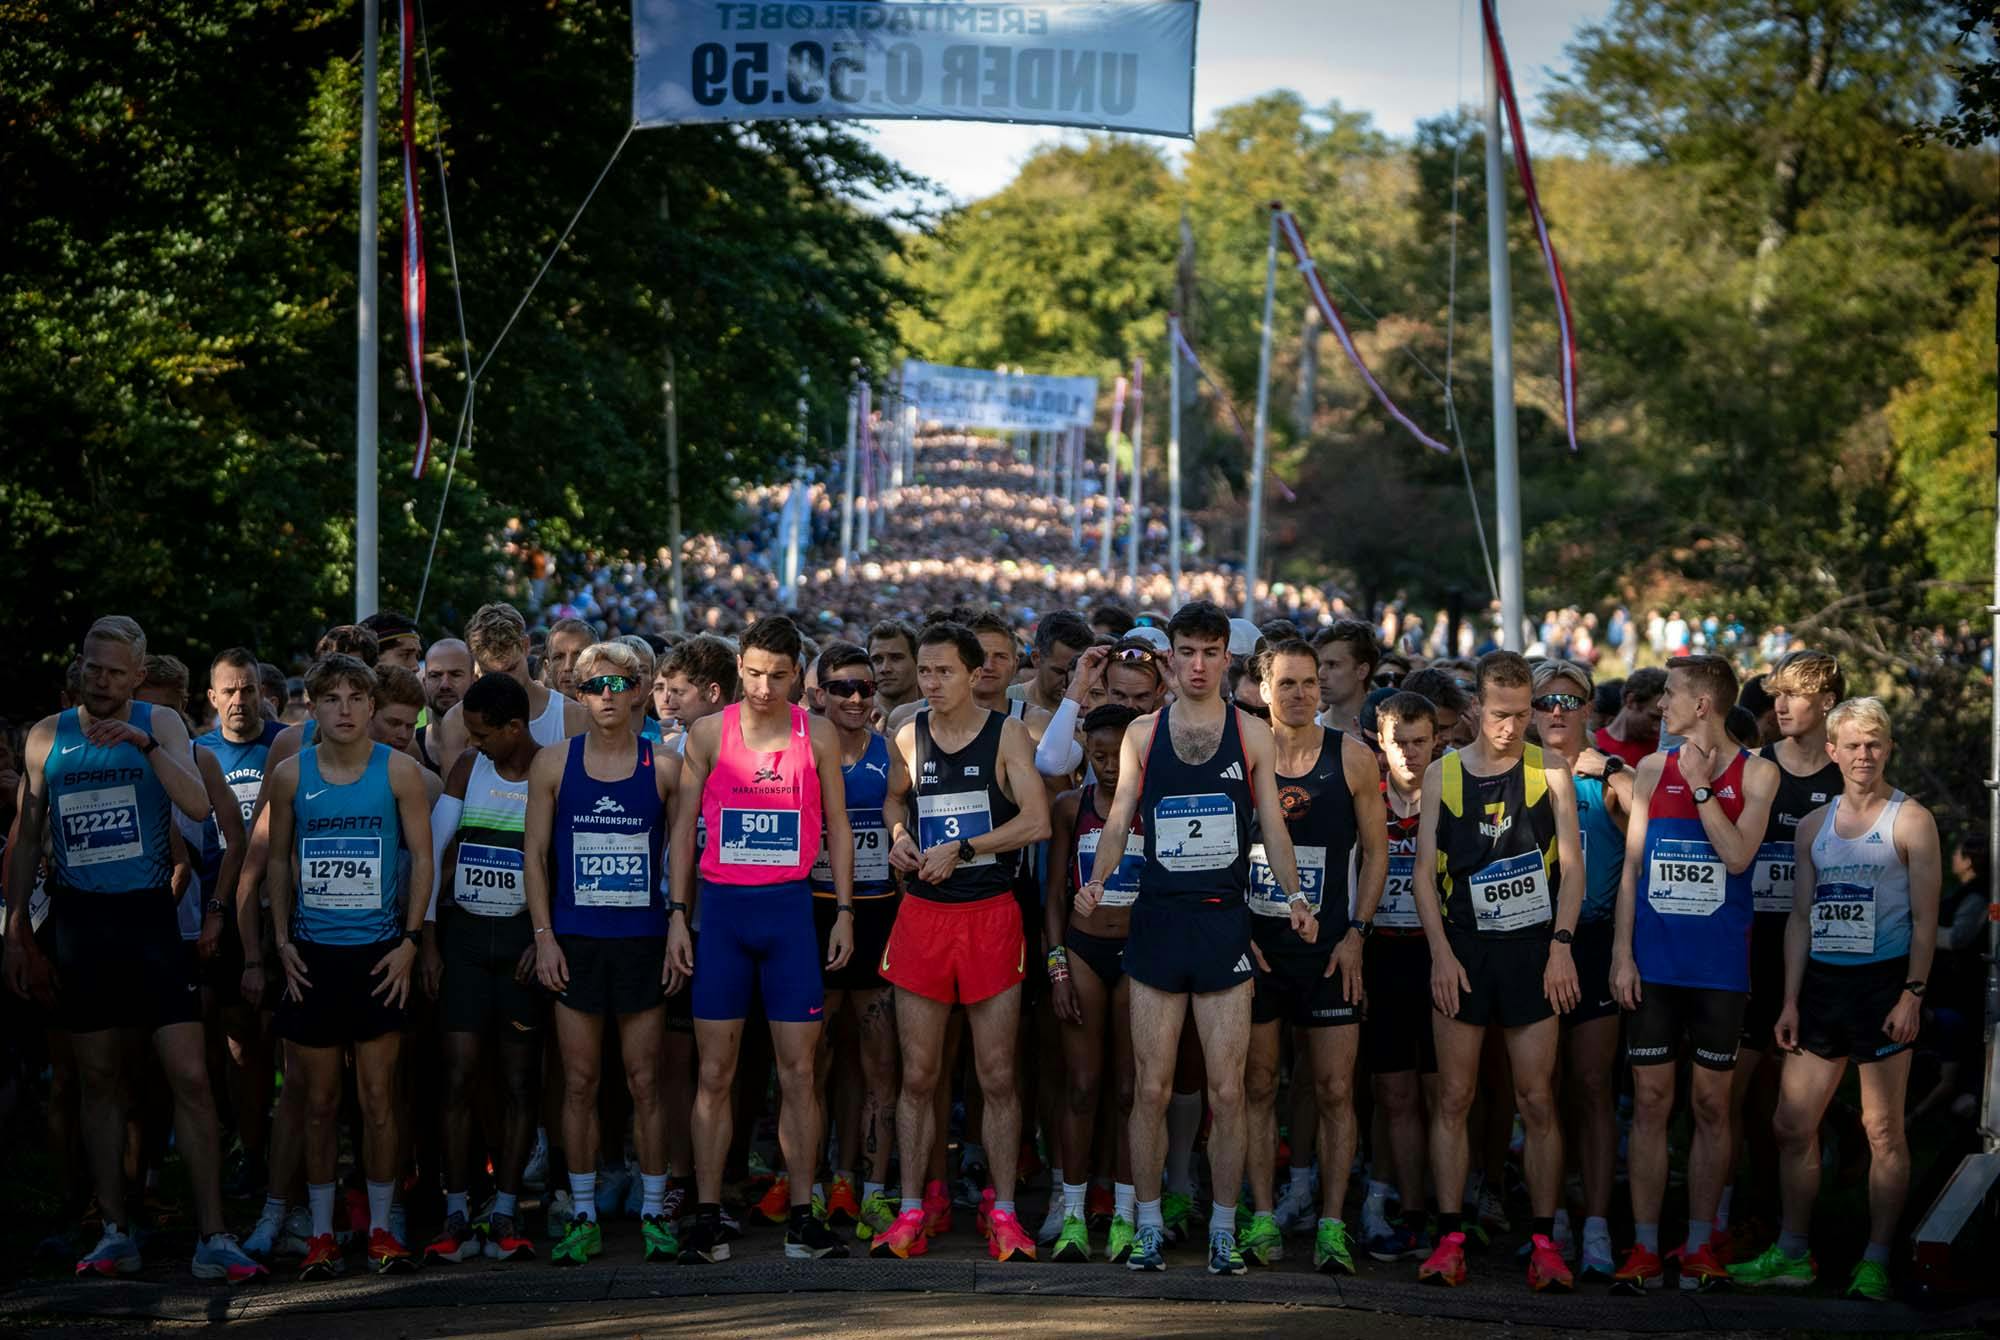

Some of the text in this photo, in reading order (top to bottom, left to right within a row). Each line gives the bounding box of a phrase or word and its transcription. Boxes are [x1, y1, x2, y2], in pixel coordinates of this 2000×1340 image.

[63, 767, 144, 785] SPARTA
[920, 775, 938, 785] HRC
[732, 786, 800, 795] MARATHONSPORT
[66, 809, 132, 836] 12222
[307, 816, 382, 831] SPARTA
[573, 815, 643, 826] MARATHONSPORT
[741, 813, 779, 834] 501
[944, 816, 960, 838] 3
[1187, 819, 1202, 838] 2
[821, 831, 878, 851] 179
[309, 860, 372, 878] 12794
[580, 856, 643, 876] 12032
[1659, 863, 1714, 884] 11362
[465, 868, 516, 889] 12018
[1256, 865, 1316, 890] 123
[1484, 876, 1536, 903] 6609
